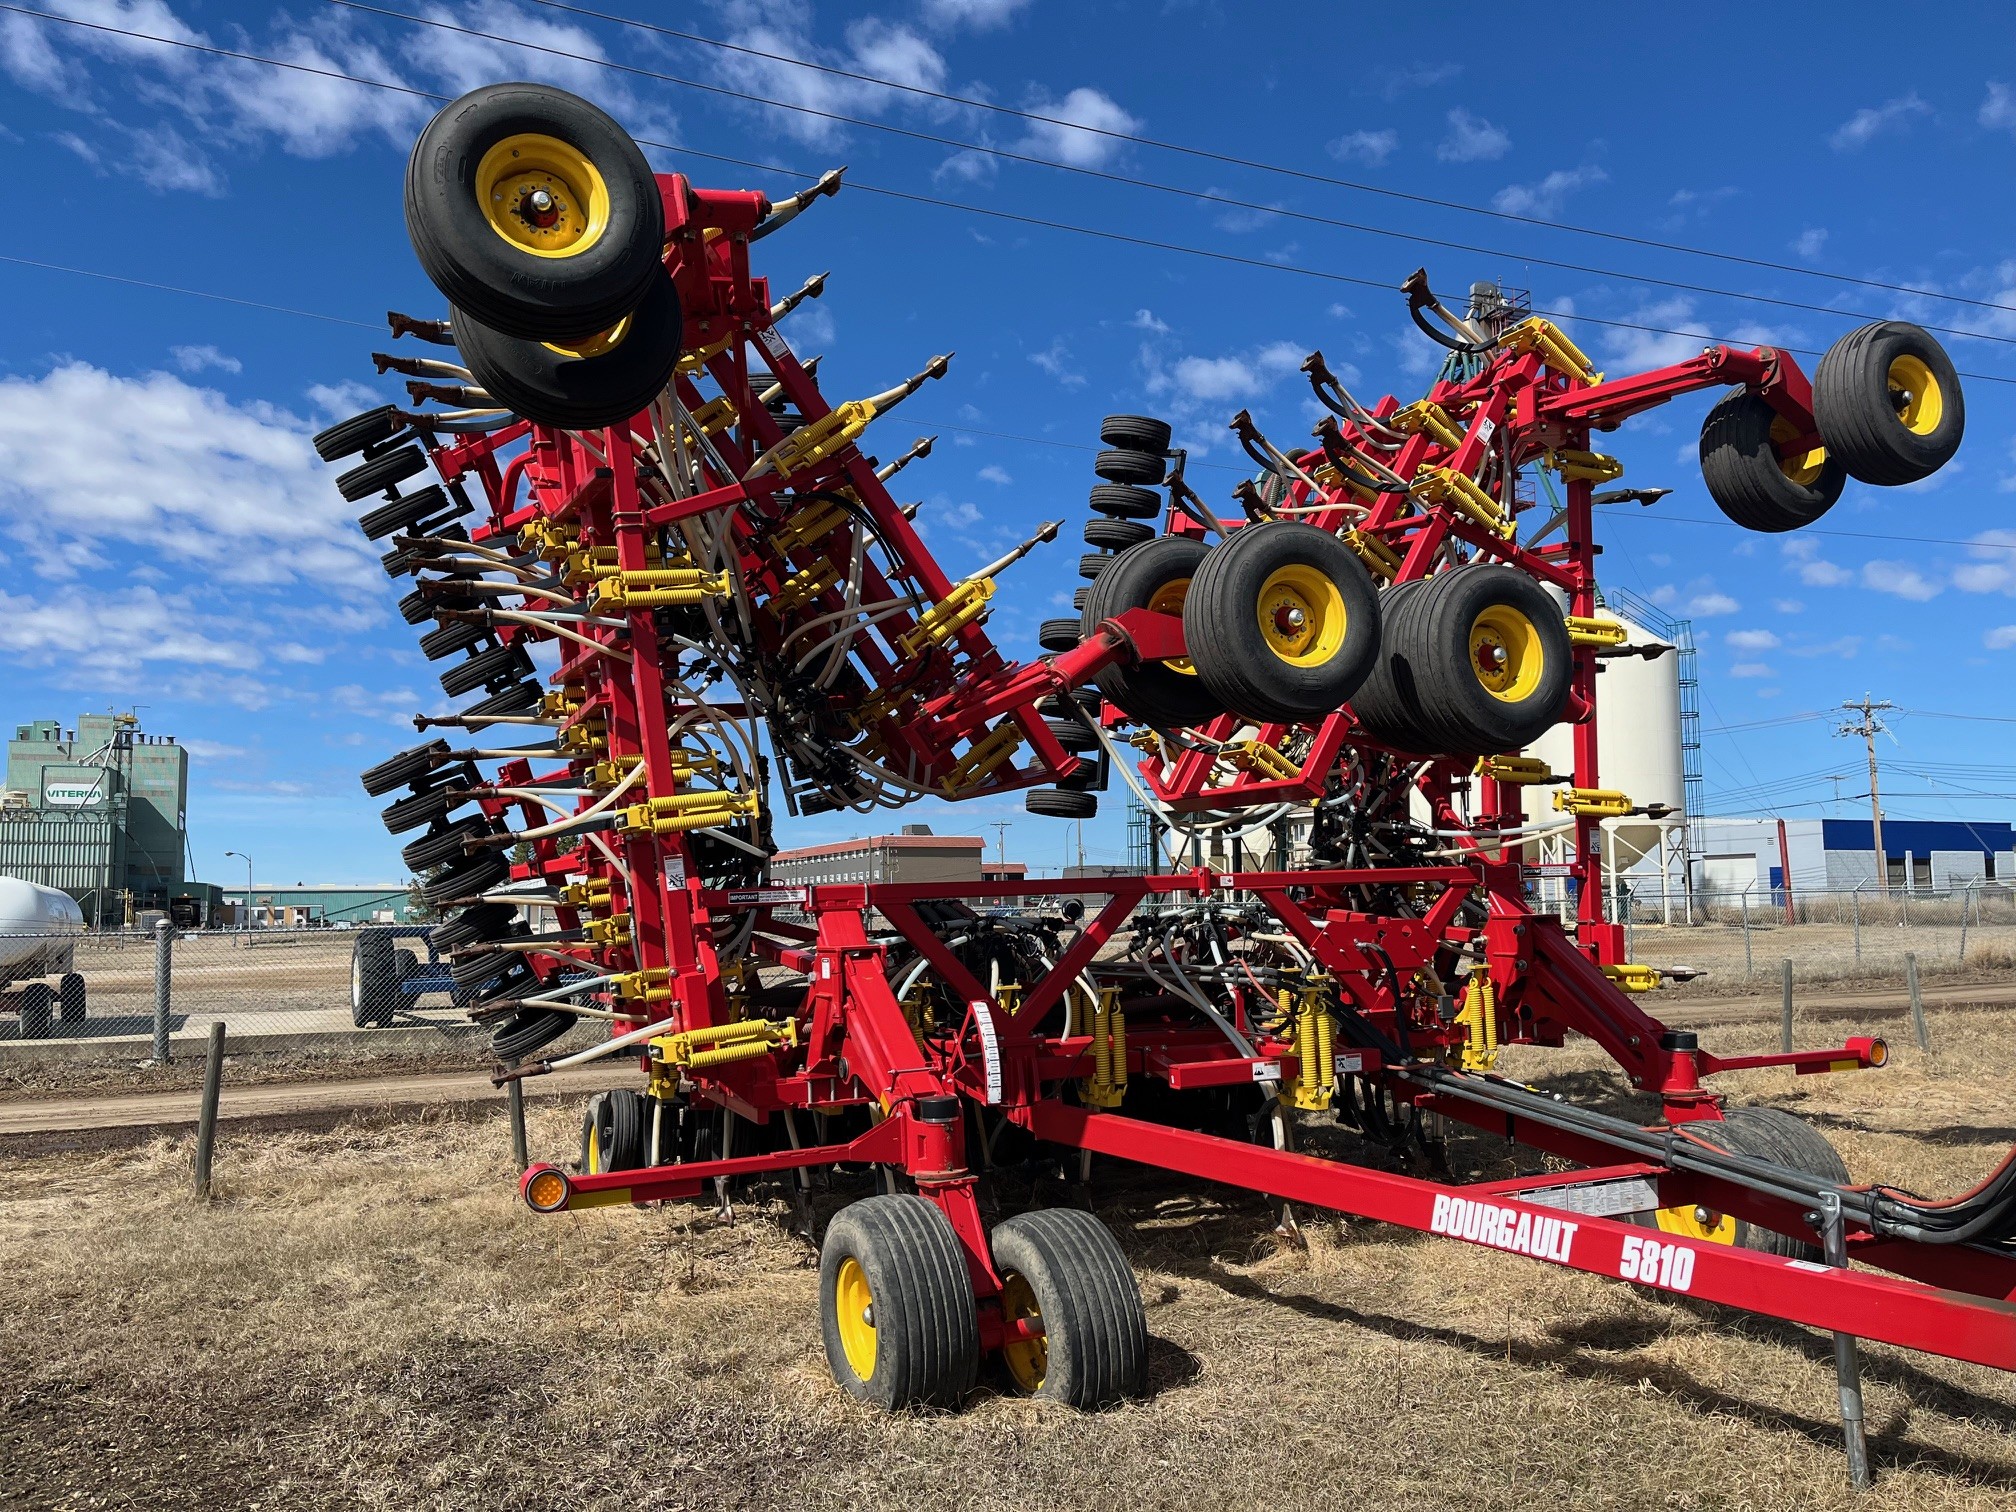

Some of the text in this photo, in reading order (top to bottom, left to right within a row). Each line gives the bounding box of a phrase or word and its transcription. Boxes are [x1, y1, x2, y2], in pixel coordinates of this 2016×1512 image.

[47, 790, 102, 798] VITERRA
[1430, 1194, 1579, 1263] BOURGAULT
[1620, 1235, 1696, 1292] 5810
